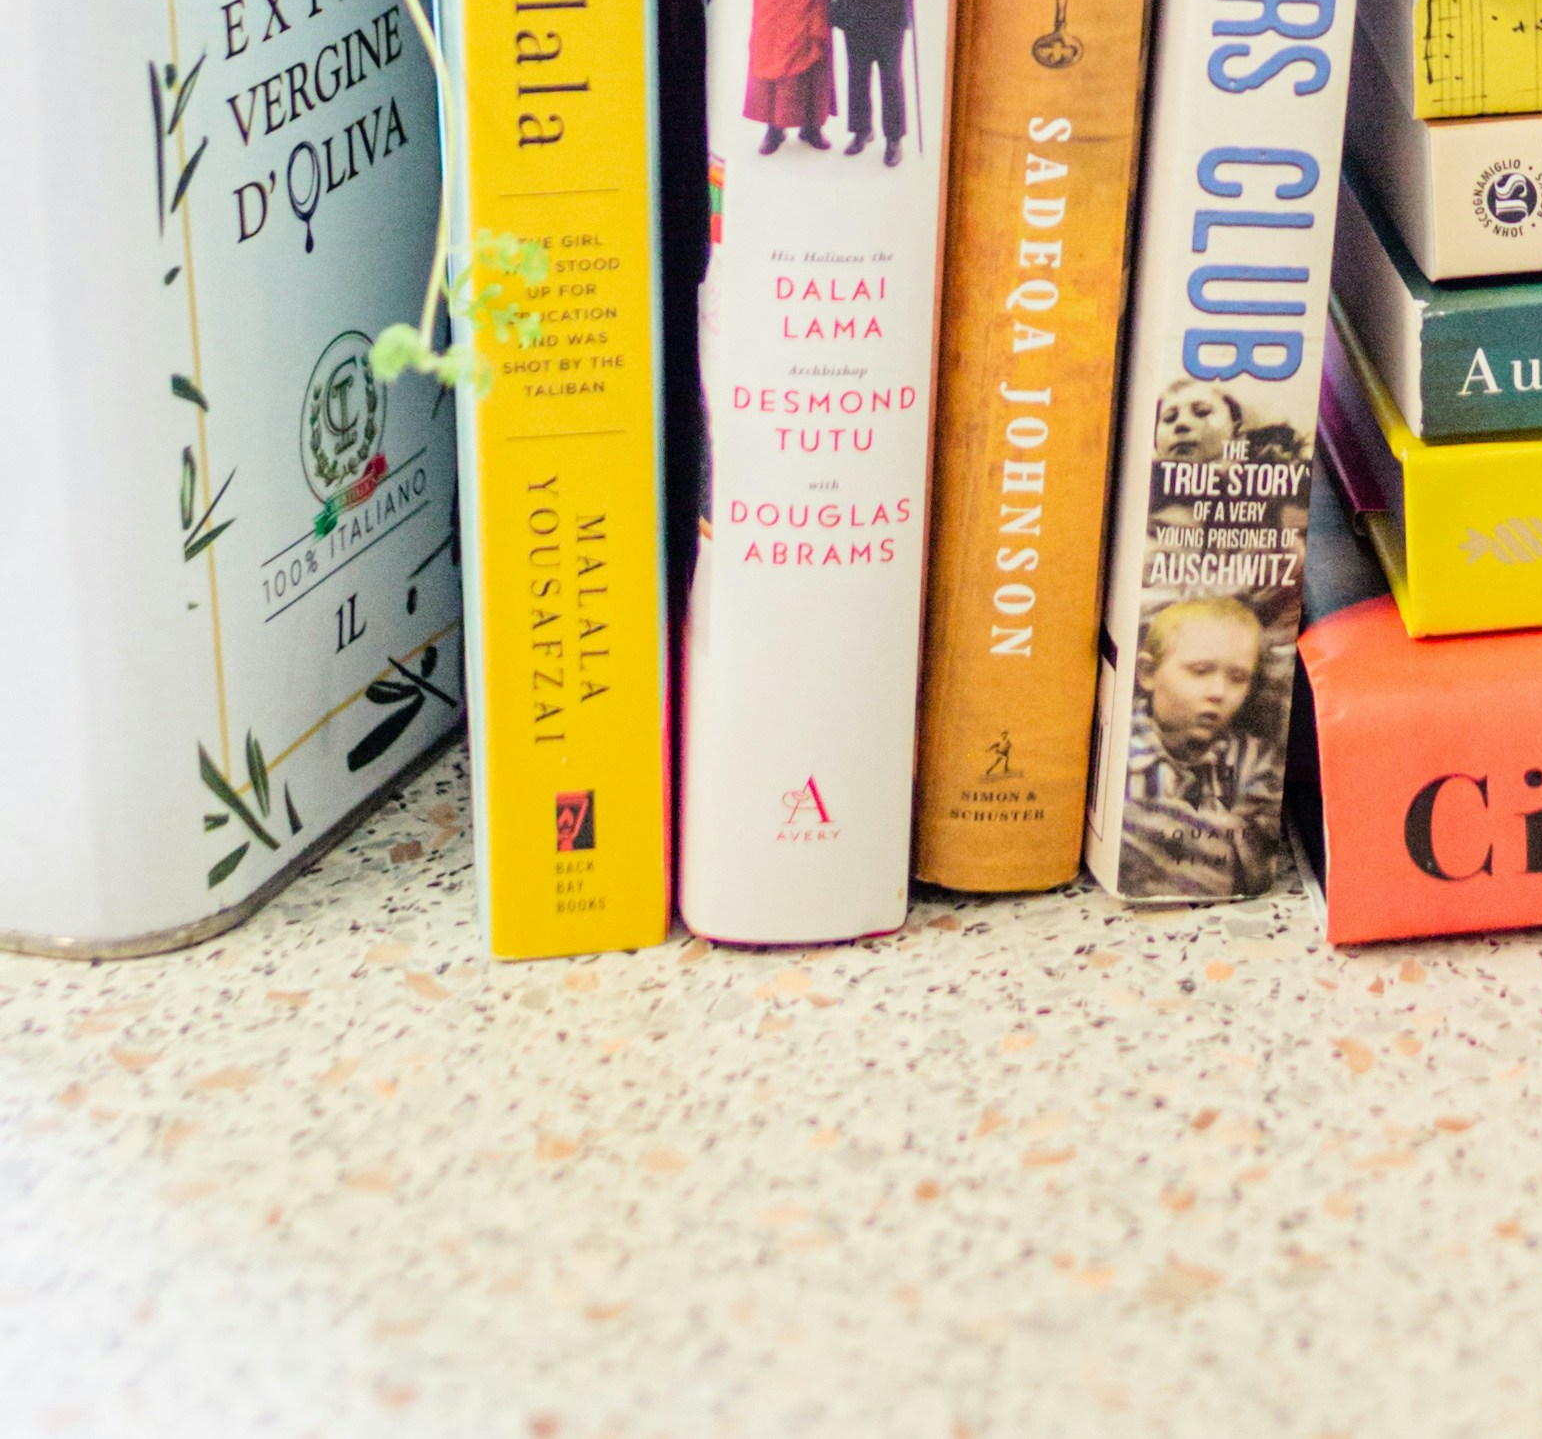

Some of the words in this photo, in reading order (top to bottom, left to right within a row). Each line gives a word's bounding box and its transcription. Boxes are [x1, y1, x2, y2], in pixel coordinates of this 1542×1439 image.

[226, 6, 403, 147] VERGINE
[1006, 116, 1073, 356] SADEQA
[556, 258, 620, 272] STOOD
[1182, 147, 1320, 382] CLUB
[776, 276, 886, 302] DALAI
[783, 316, 883, 340] LAMA
[524, 382, 605, 397] TALIBAN
[733, 386, 917, 414] DESMOND
[775, 428, 874, 452] TUTU
[1161, 461, 1224, 498] TRUE
[1227, 463, 1305, 497] STORY
[731, 498, 911, 528] DOUGLAS
[990, 385, 1053, 659] JOHNSON
[262, 549, 318, 603] 100%
[330, 468, 427, 558] ITALIANO
[1156, 525, 1204, 549] YOUNG
[1208, 526, 1278, 549] PRISONER
[1281, 527, 1299, 547] OF
[744, 539, 896, 566] ABRAMS
[1150, 552, 1297, 587] AUSCHWITZ
[526, 473, 566, 745] YOUSAFZAI
[575, 512, 611, 703] MALALA
